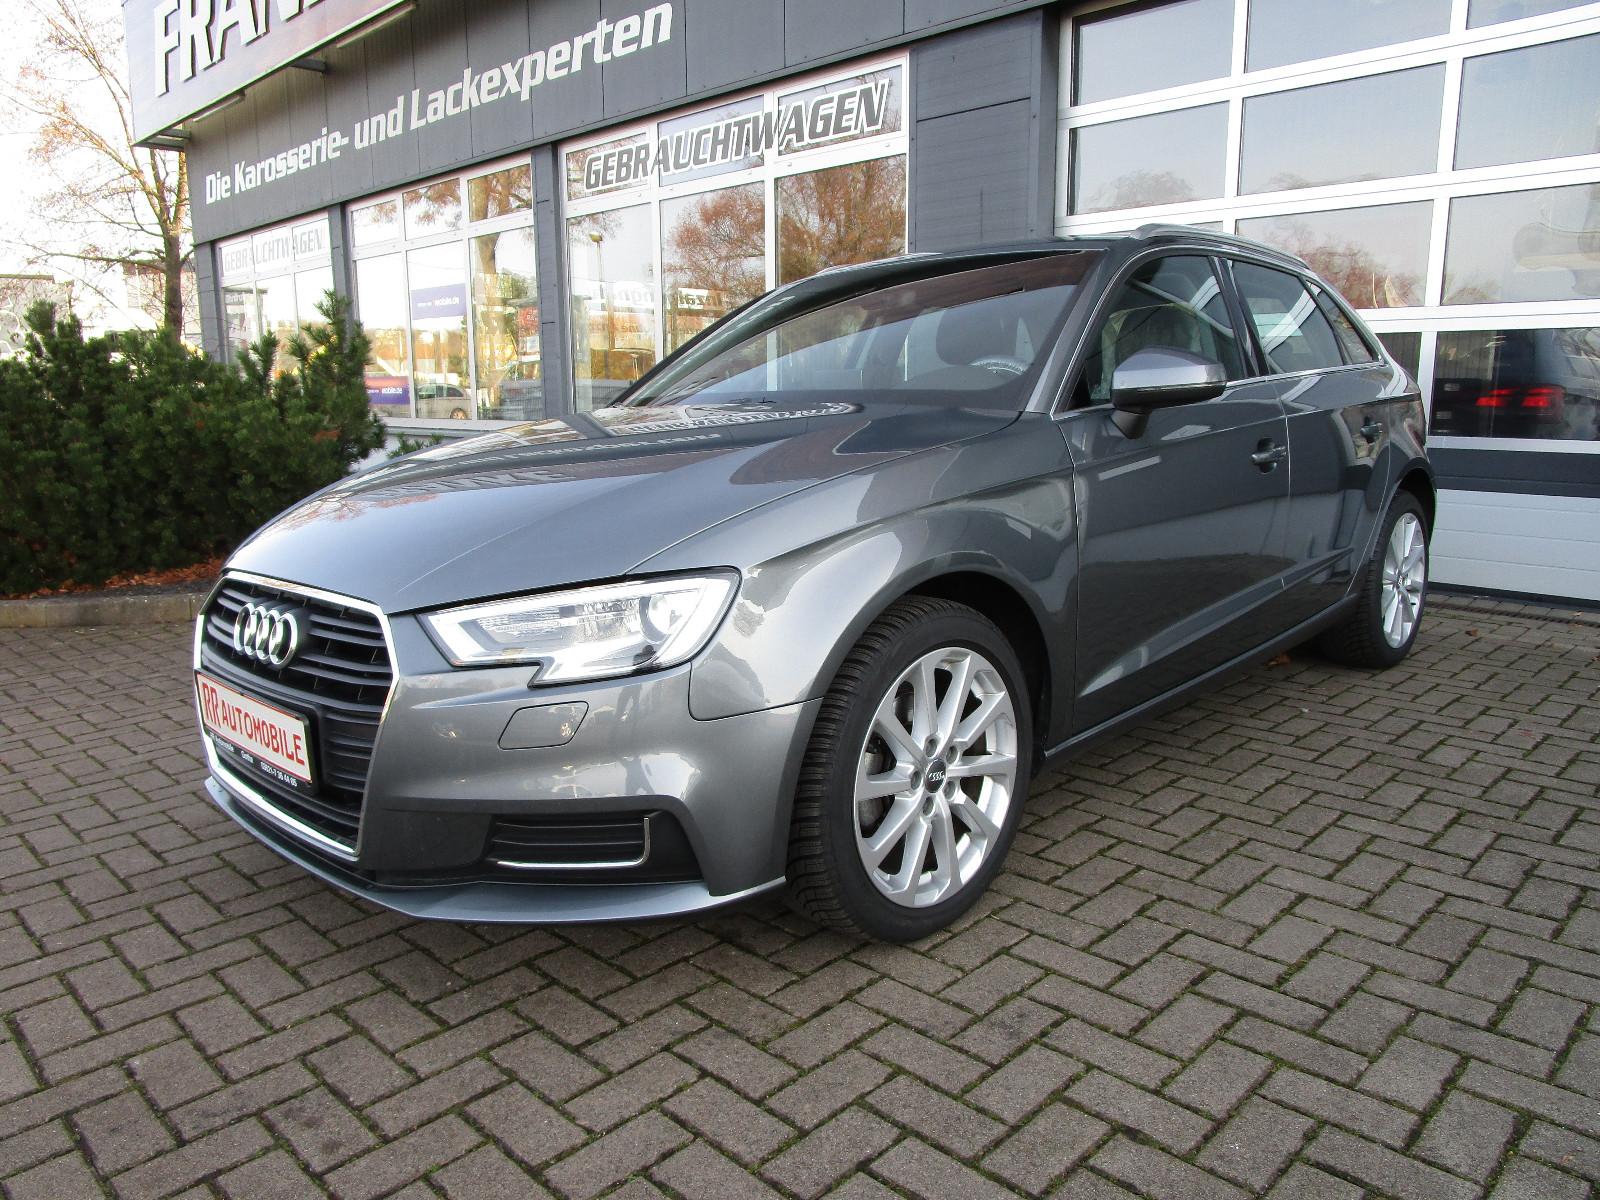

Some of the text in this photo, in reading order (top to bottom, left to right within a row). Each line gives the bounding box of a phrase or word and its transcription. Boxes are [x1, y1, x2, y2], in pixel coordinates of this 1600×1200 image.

[205, 2, 673, 204] Die Karosserie- und Lackexperten
[584, 78, 890, 190] GEBRAUCHTWAGEN
[202, 683, 305, 766] RR AUTOMOBILE
